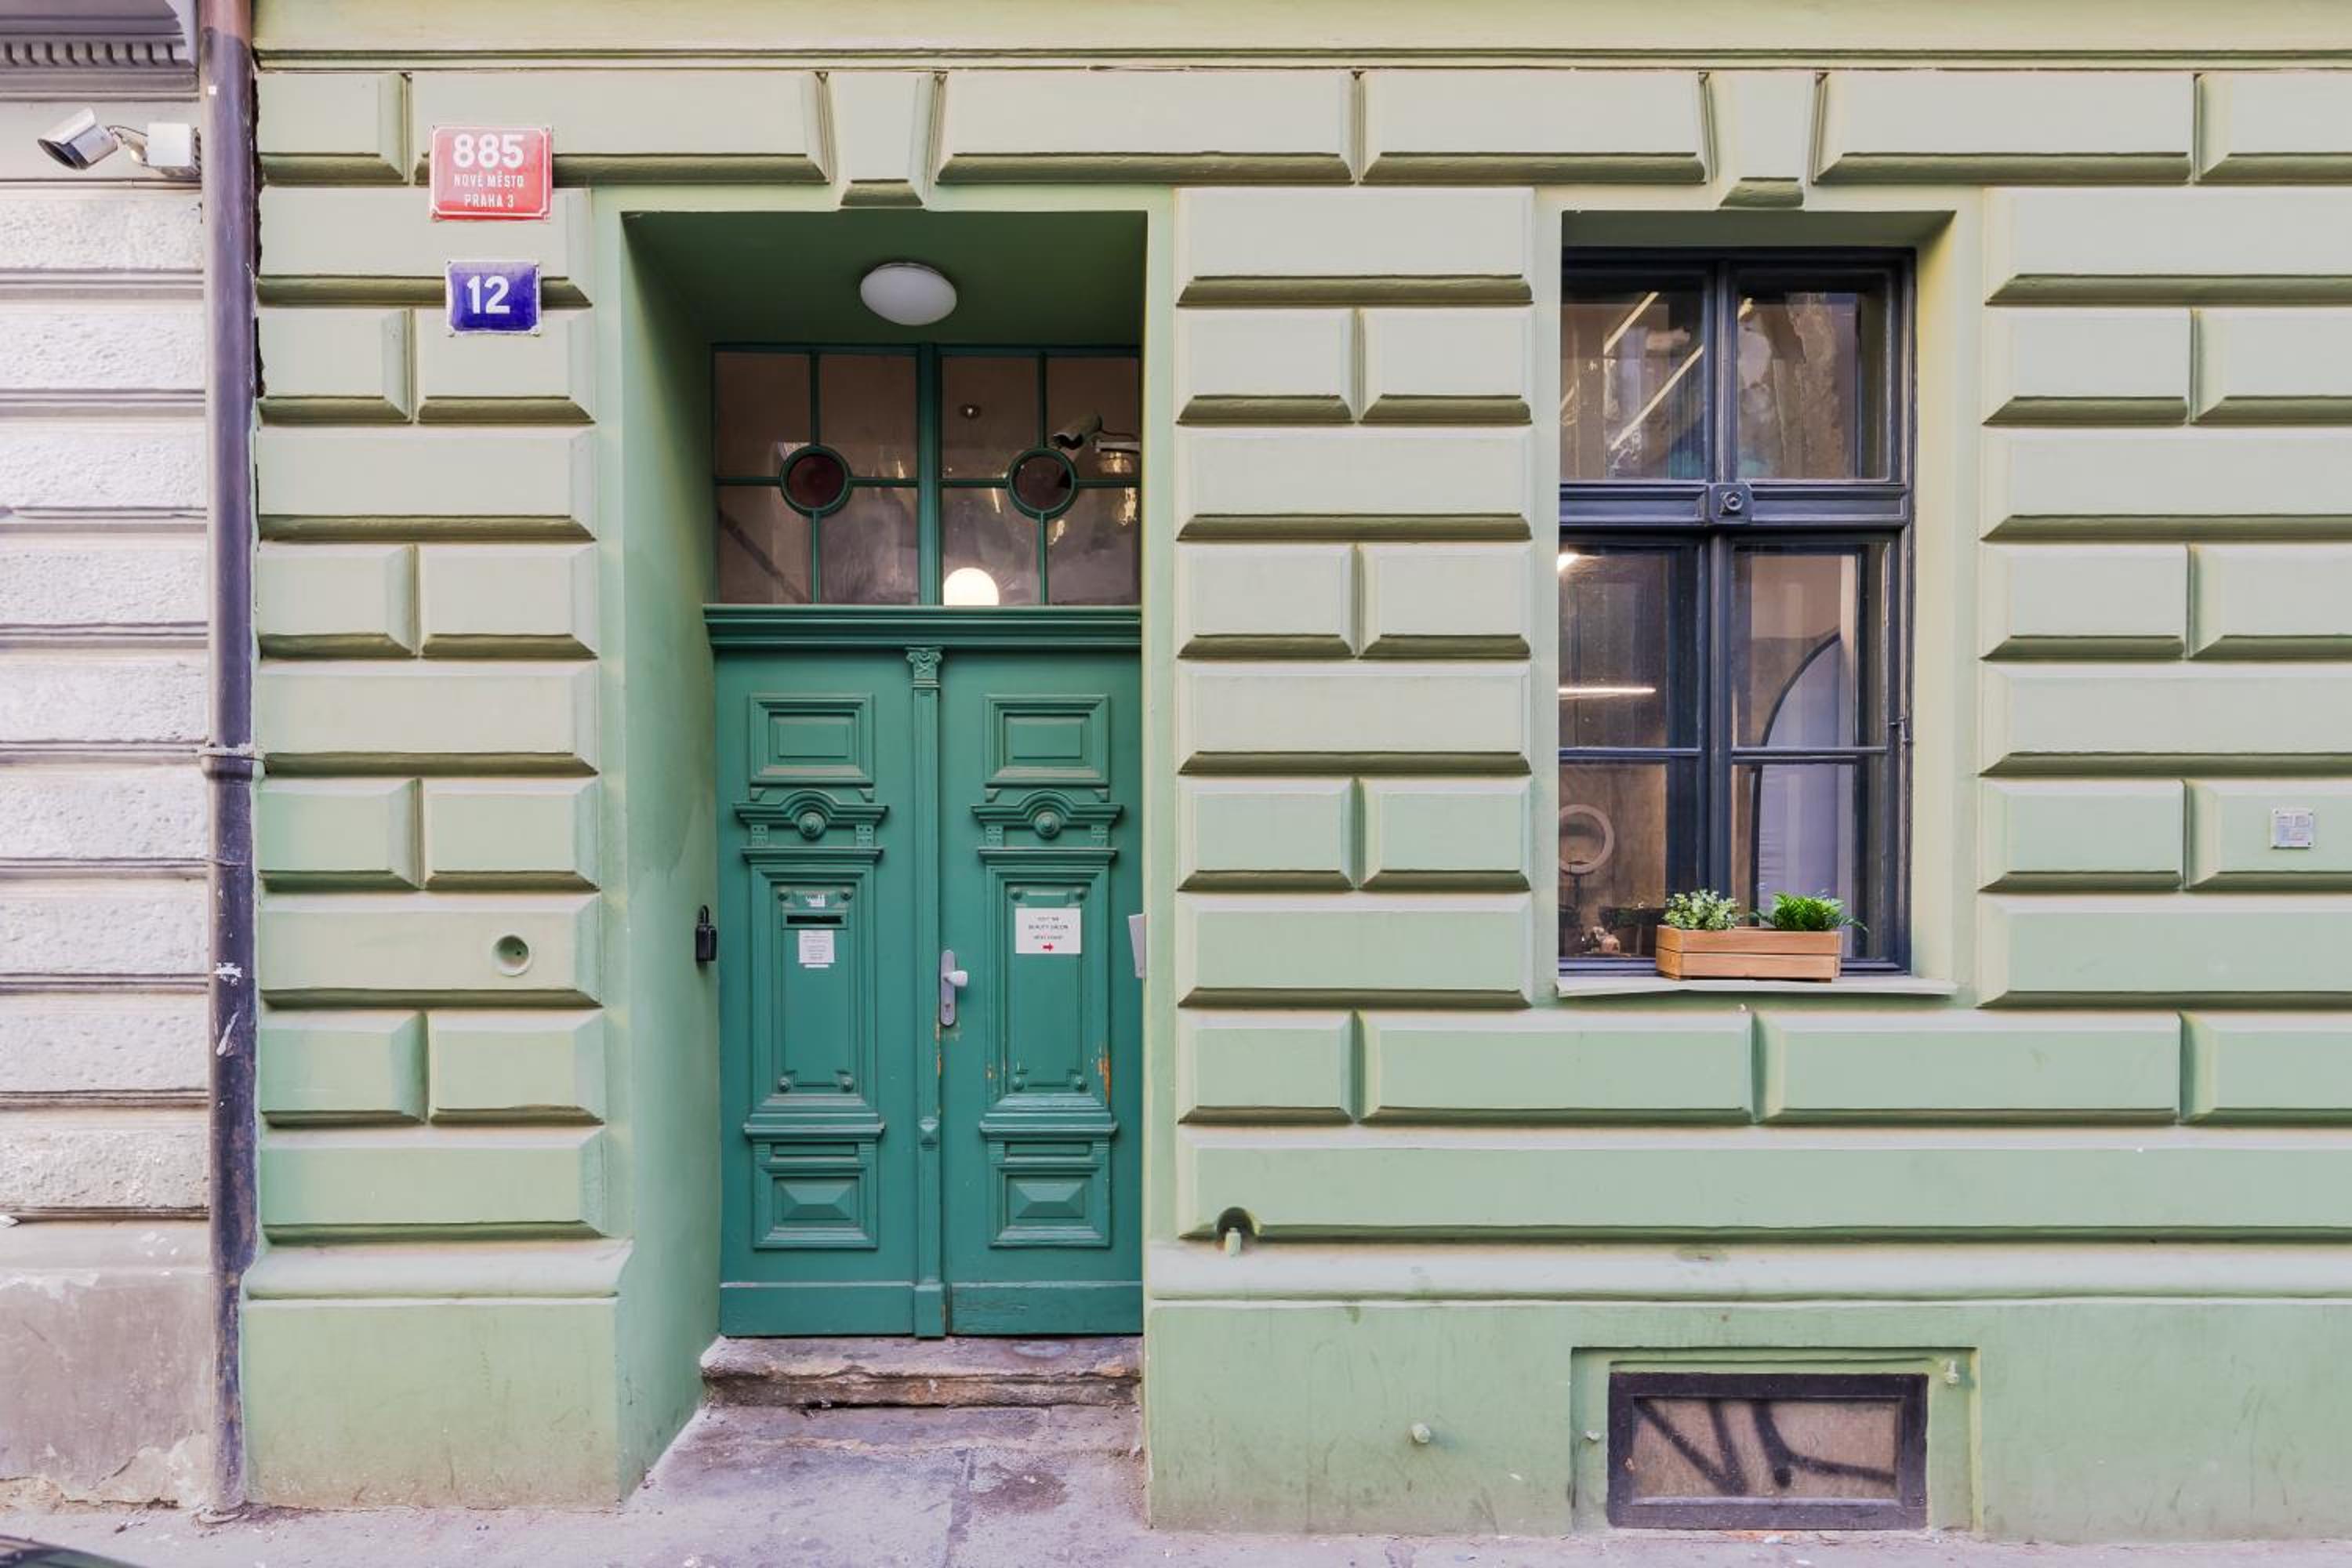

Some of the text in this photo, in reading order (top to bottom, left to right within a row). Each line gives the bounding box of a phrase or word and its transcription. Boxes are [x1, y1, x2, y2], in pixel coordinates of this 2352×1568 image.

[453, 133, 524, 168] 885
[464, 194, 514, 208] PRAHA 3
[466, 275, 510, 314] 12
